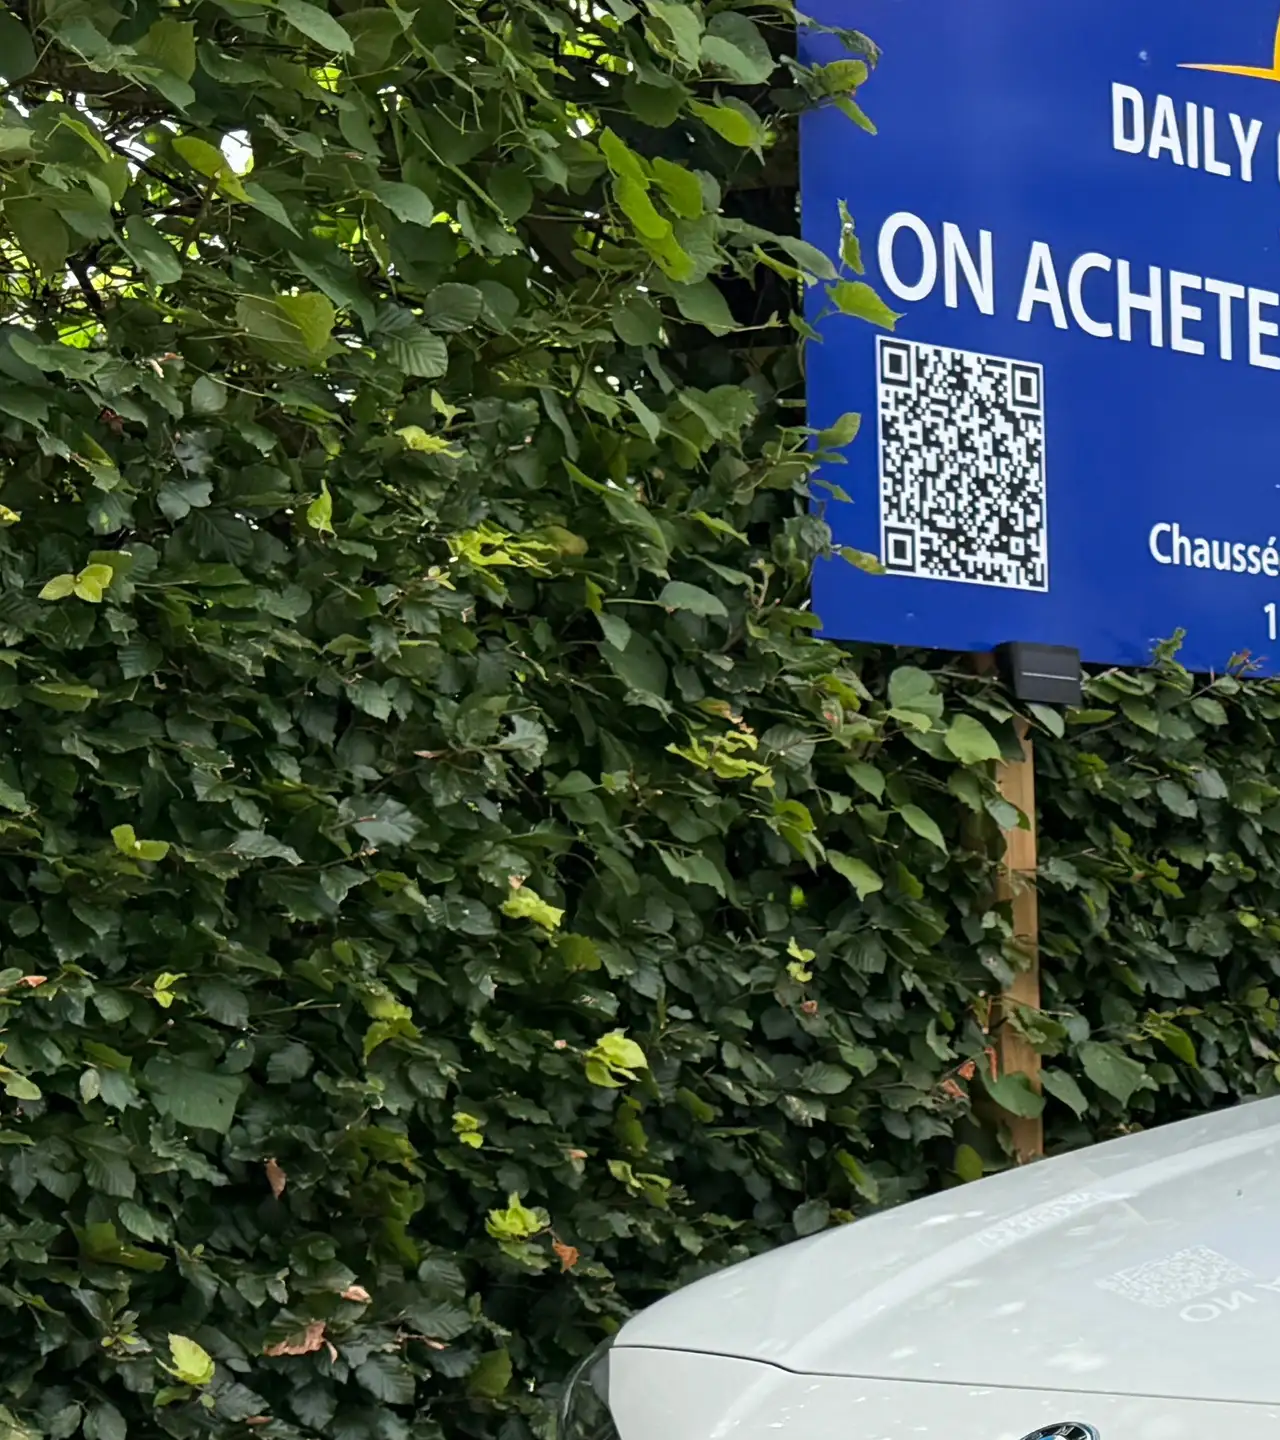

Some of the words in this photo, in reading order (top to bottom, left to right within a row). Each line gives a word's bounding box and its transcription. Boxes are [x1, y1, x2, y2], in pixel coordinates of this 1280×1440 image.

[1112, 83, 1262, 181] DAILY
[877, 212, 994, 316] ON
[1018, 241, 1280, 369] ACHETE
